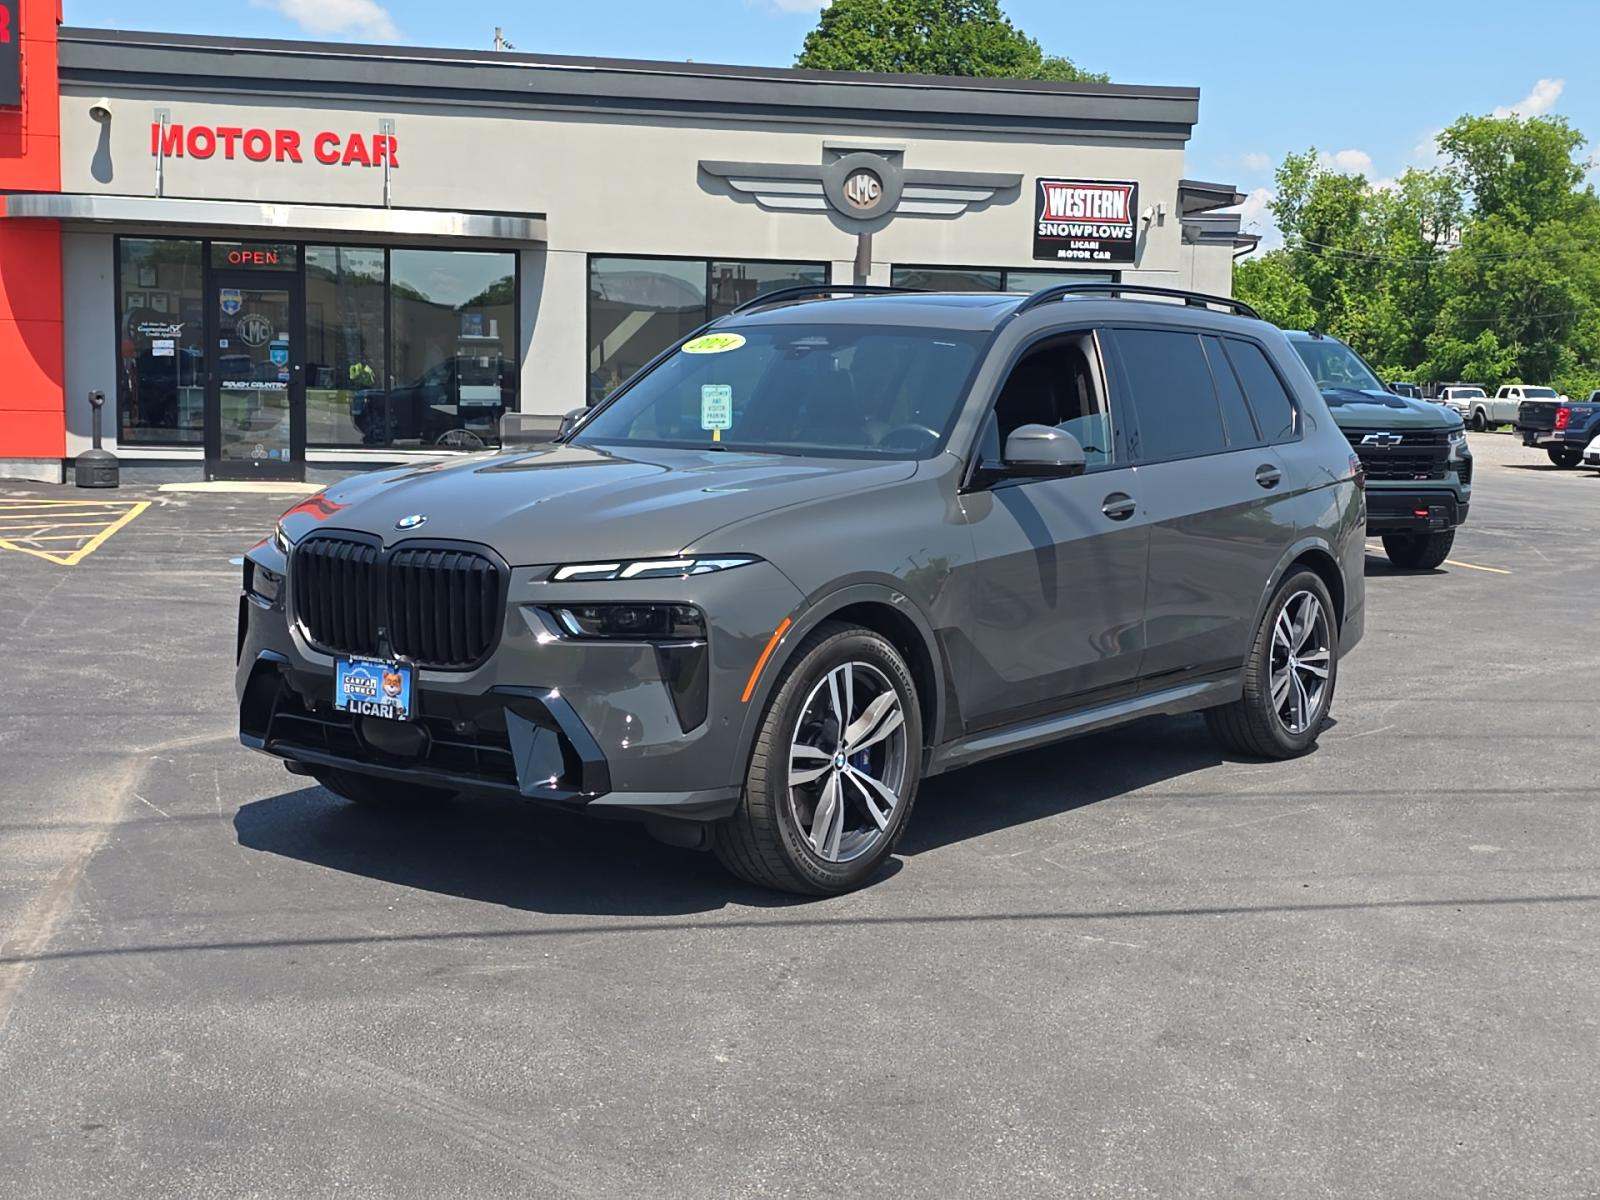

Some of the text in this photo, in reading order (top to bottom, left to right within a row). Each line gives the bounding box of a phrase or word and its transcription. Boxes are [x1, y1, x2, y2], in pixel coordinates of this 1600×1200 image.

[151, 123, 399, 167] MOTOR CAR
[848, 174, 878, 202] LMC
[1048, 187, 1125, 219] WESTERN
[1038, 223, 1133, 239] SNOWPLOWS
[1057, 250, 1112, 260] MOTOR CAR
[1070, 241, 1100, 250] LICARI
[228, 251, 278, 264] OPEN
[240, 320, 269, 343] LMC
[349, 700, 394, 719] LICARI
